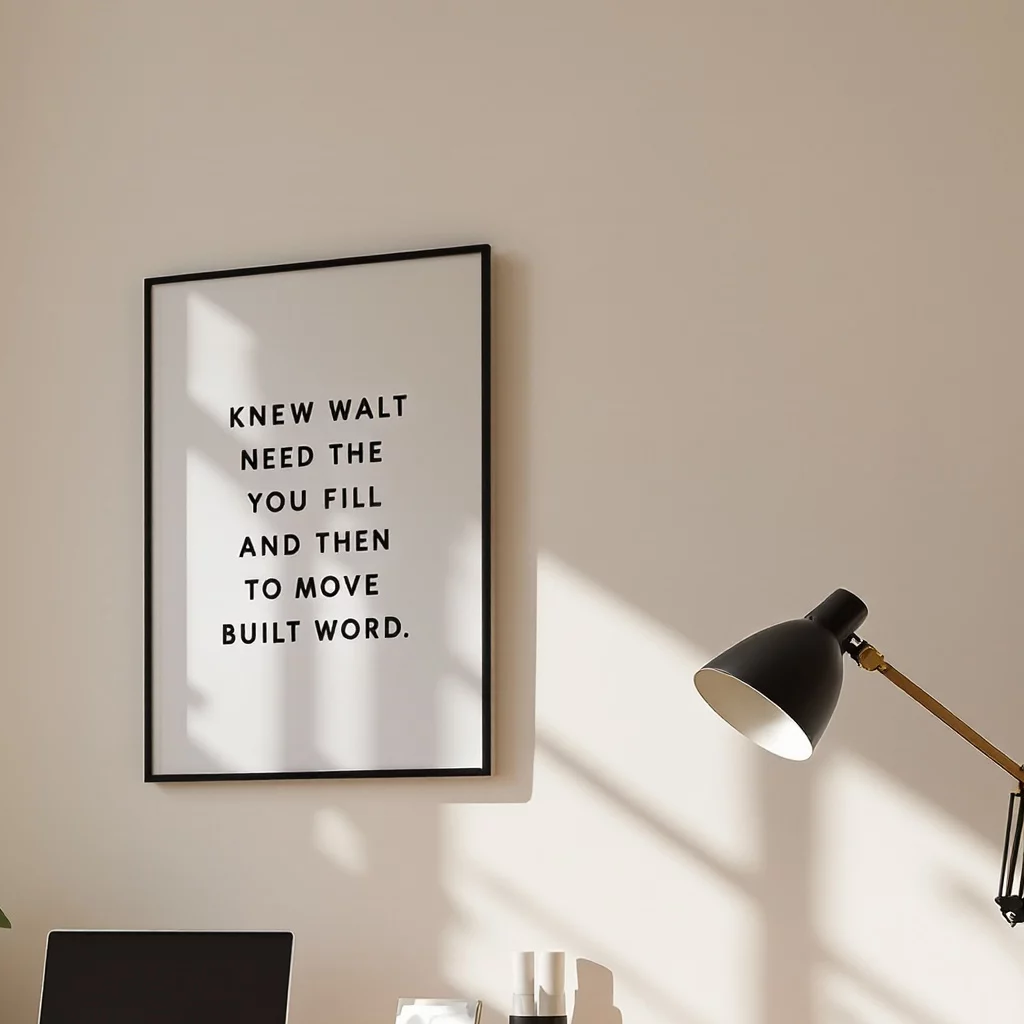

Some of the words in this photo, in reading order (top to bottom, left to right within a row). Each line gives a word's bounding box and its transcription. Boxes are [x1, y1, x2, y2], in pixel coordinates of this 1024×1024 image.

[230, 402, 314, 427] KNEW
[329, 395, 408, 421] WALT
[241, 446, 314, 470] NEED
[329, 441, 383, 464] THE
[248, 490, 307, 513] YOU
[324, 486, 382, 509] FILL
[239, 534, 301, 557] AND
[316, 529, 390, 553] THEN
[245, 578, 282, 600] TO
[295, 574, 379, 598] MOVE
[222, 621, 301, 645] BUILT
[314, 617, 409, 641] WORD.
